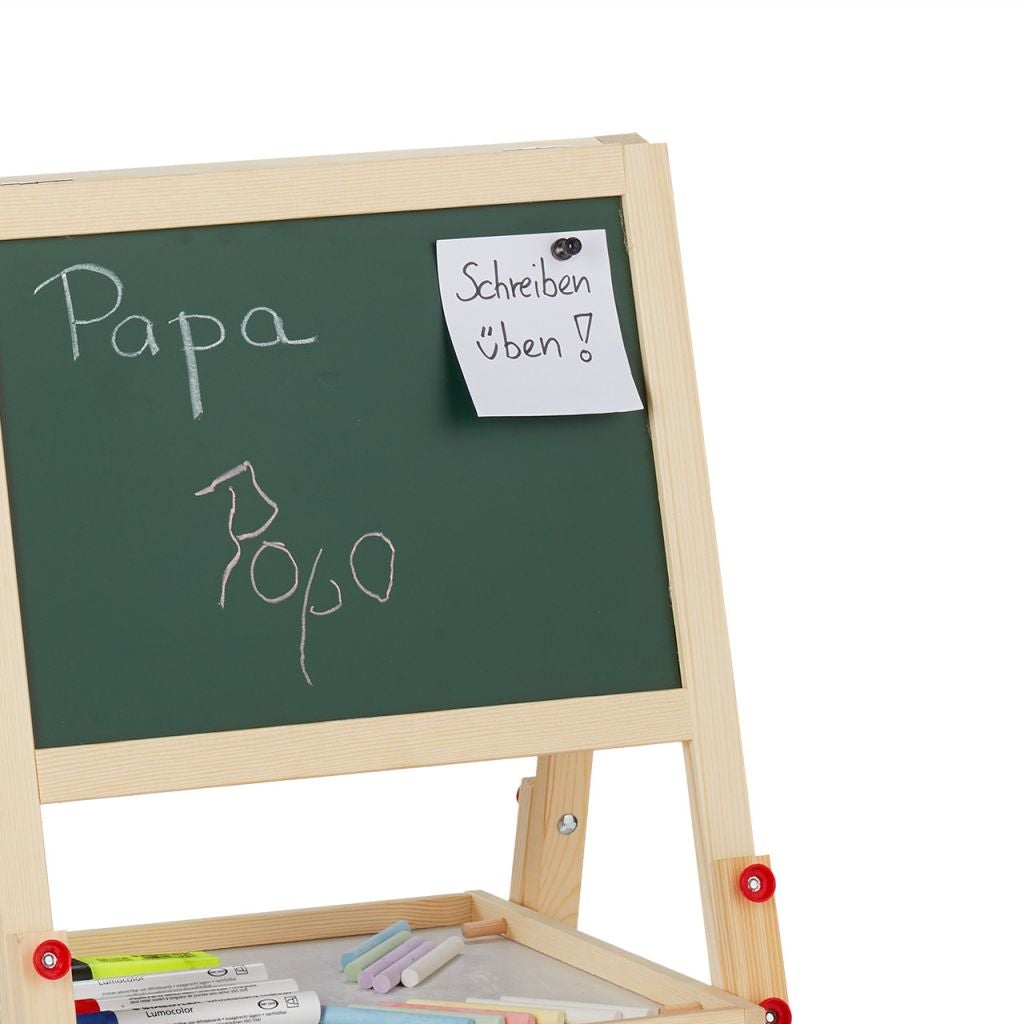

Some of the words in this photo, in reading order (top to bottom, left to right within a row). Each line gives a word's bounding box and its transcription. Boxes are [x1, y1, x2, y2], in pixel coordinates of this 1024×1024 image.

[455, 262, 591, 303] Schreiben
[34, 263, 318, 420] Papa
[194, 460, 396, 686] Popo
[98, 976, 144, 986] Lumocolor
[146, 1007, 193, 1018] Lumocolor
